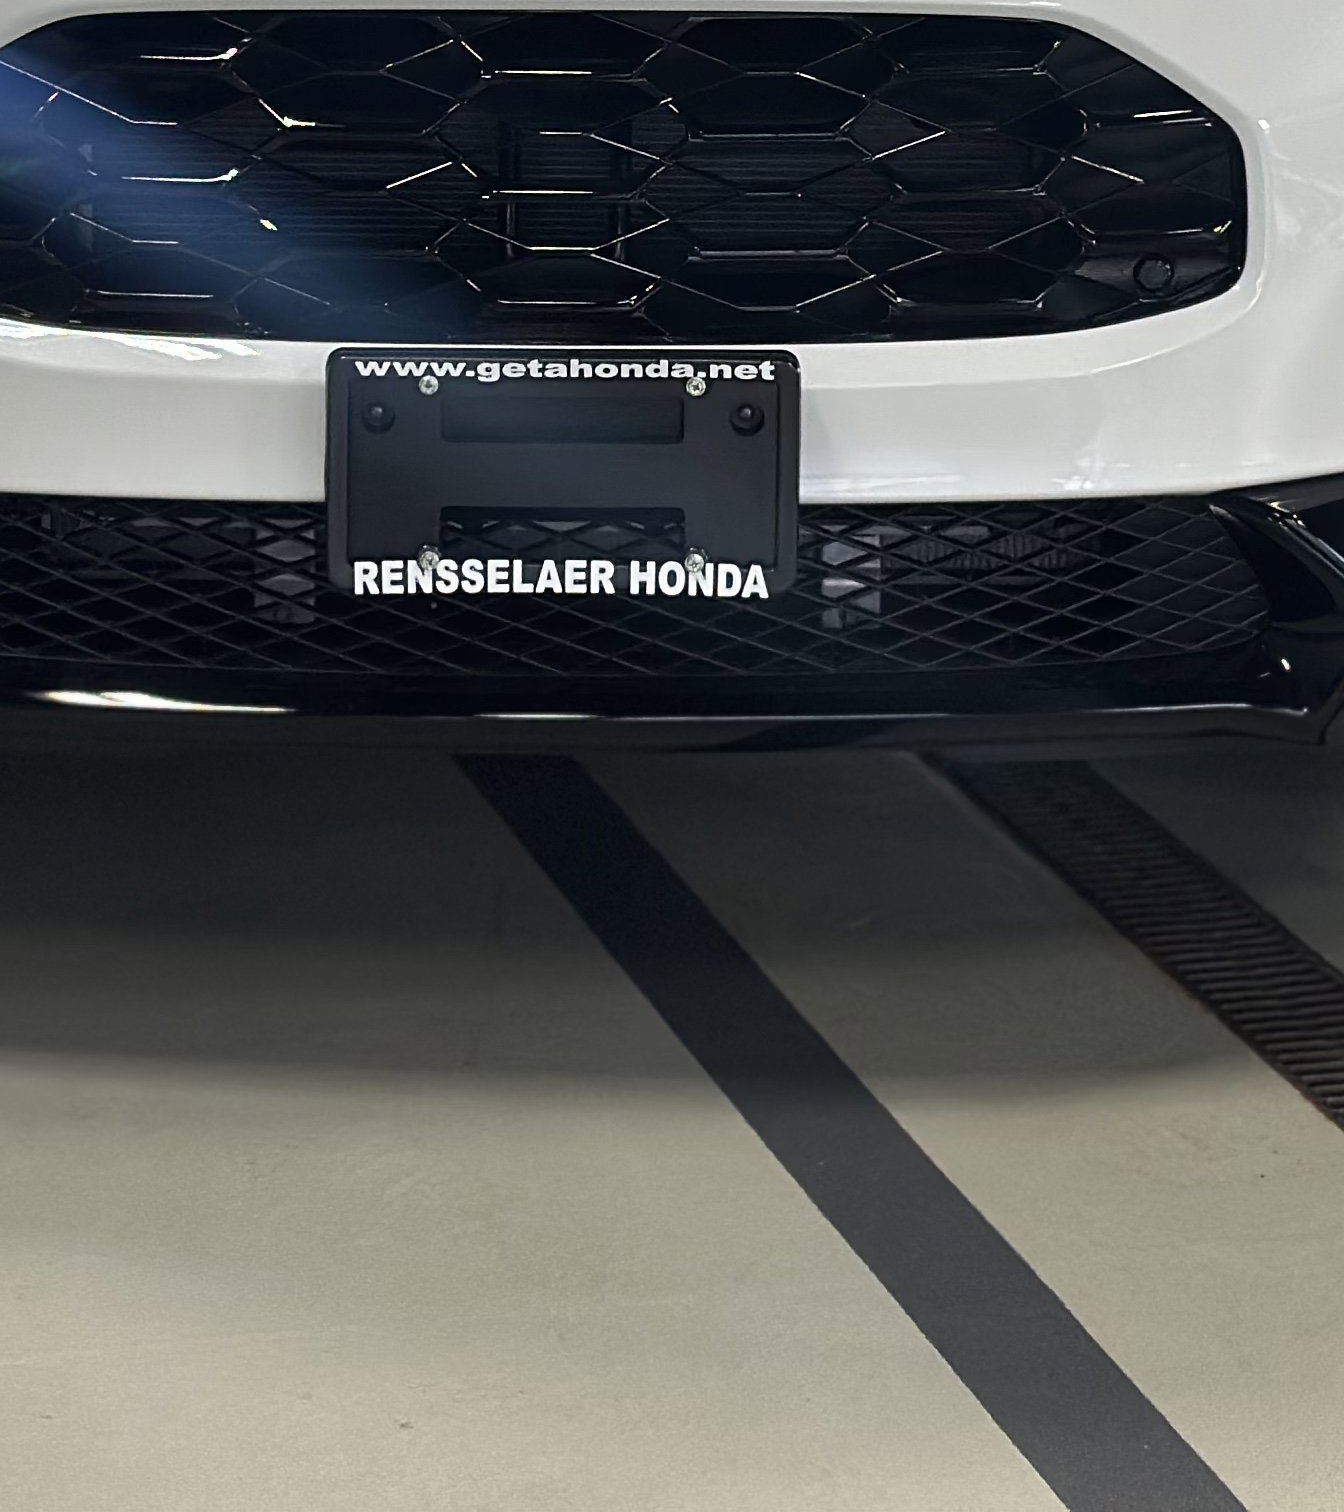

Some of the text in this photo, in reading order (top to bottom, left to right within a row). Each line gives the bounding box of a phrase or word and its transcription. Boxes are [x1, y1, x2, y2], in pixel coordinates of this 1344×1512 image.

[354, 359, 776, 383] www.getahonda.net
[353, 558, 769, 599] RENSSELAER HONDA
